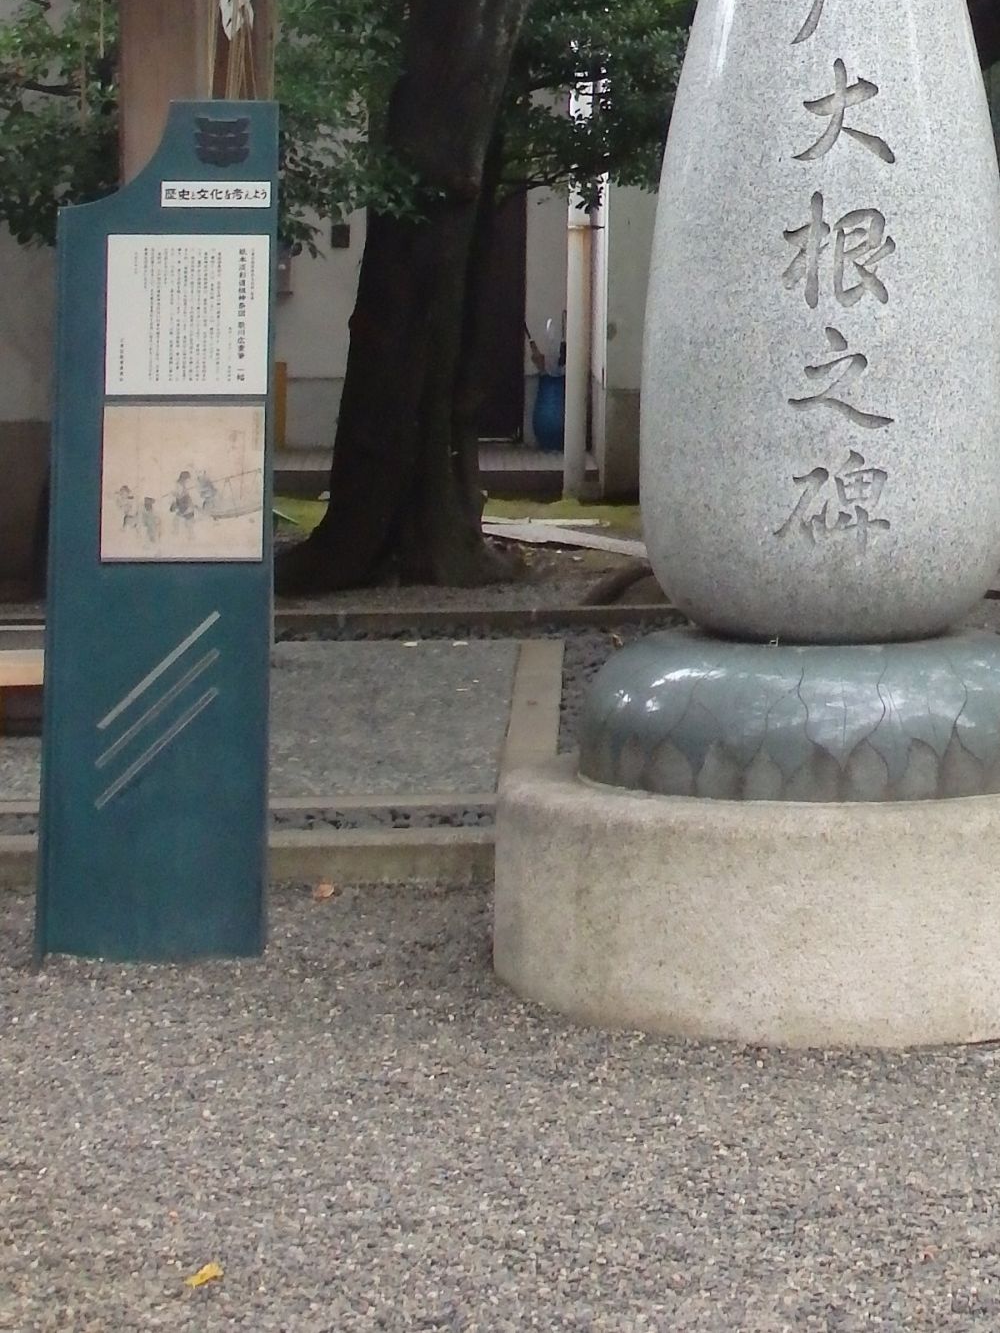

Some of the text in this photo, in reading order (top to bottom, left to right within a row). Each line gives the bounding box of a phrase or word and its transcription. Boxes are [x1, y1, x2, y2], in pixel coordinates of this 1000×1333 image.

[165, 188, 267, 201] 歴史と文化を考えよう
